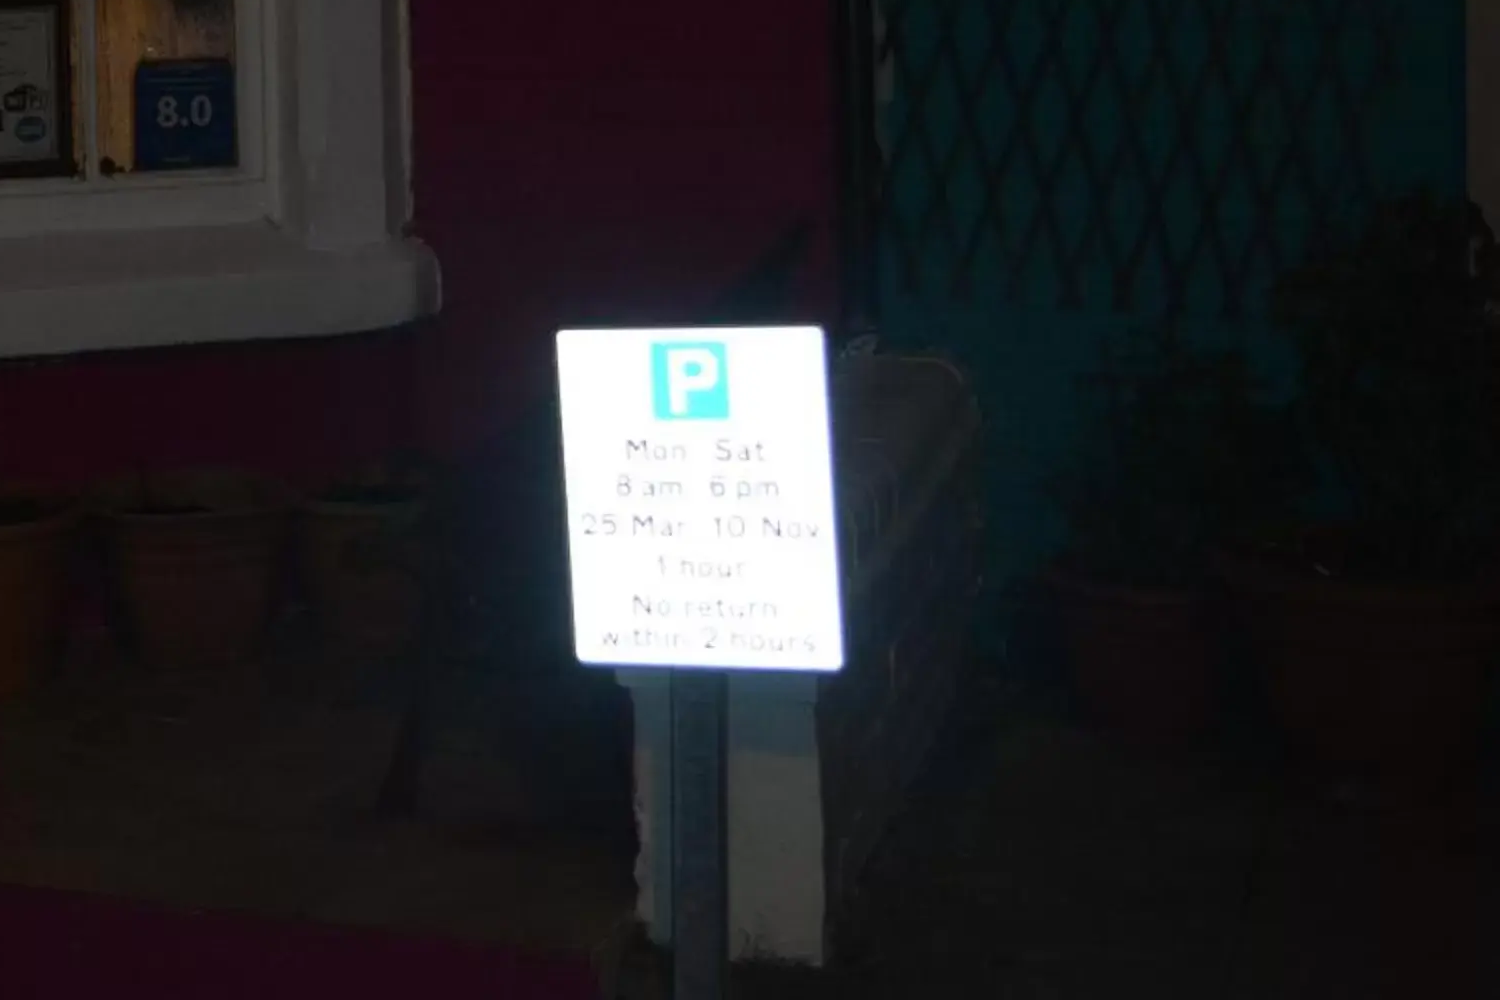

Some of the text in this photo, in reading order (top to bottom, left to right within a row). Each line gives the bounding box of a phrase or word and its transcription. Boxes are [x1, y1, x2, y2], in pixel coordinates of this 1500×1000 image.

[156, 94, 213, 128] 8.0
[667, 347, 720, 417] P
[625, 438, 767, 462] Mon Sat
[581, 513, 819, 539] 25 Mar 10 Nov
[679, 556, 747, 579] hour
[632, 594, 778, 619] No return
[702, 626, 718, 649] 2
[730, 629, 816, 653] hours
